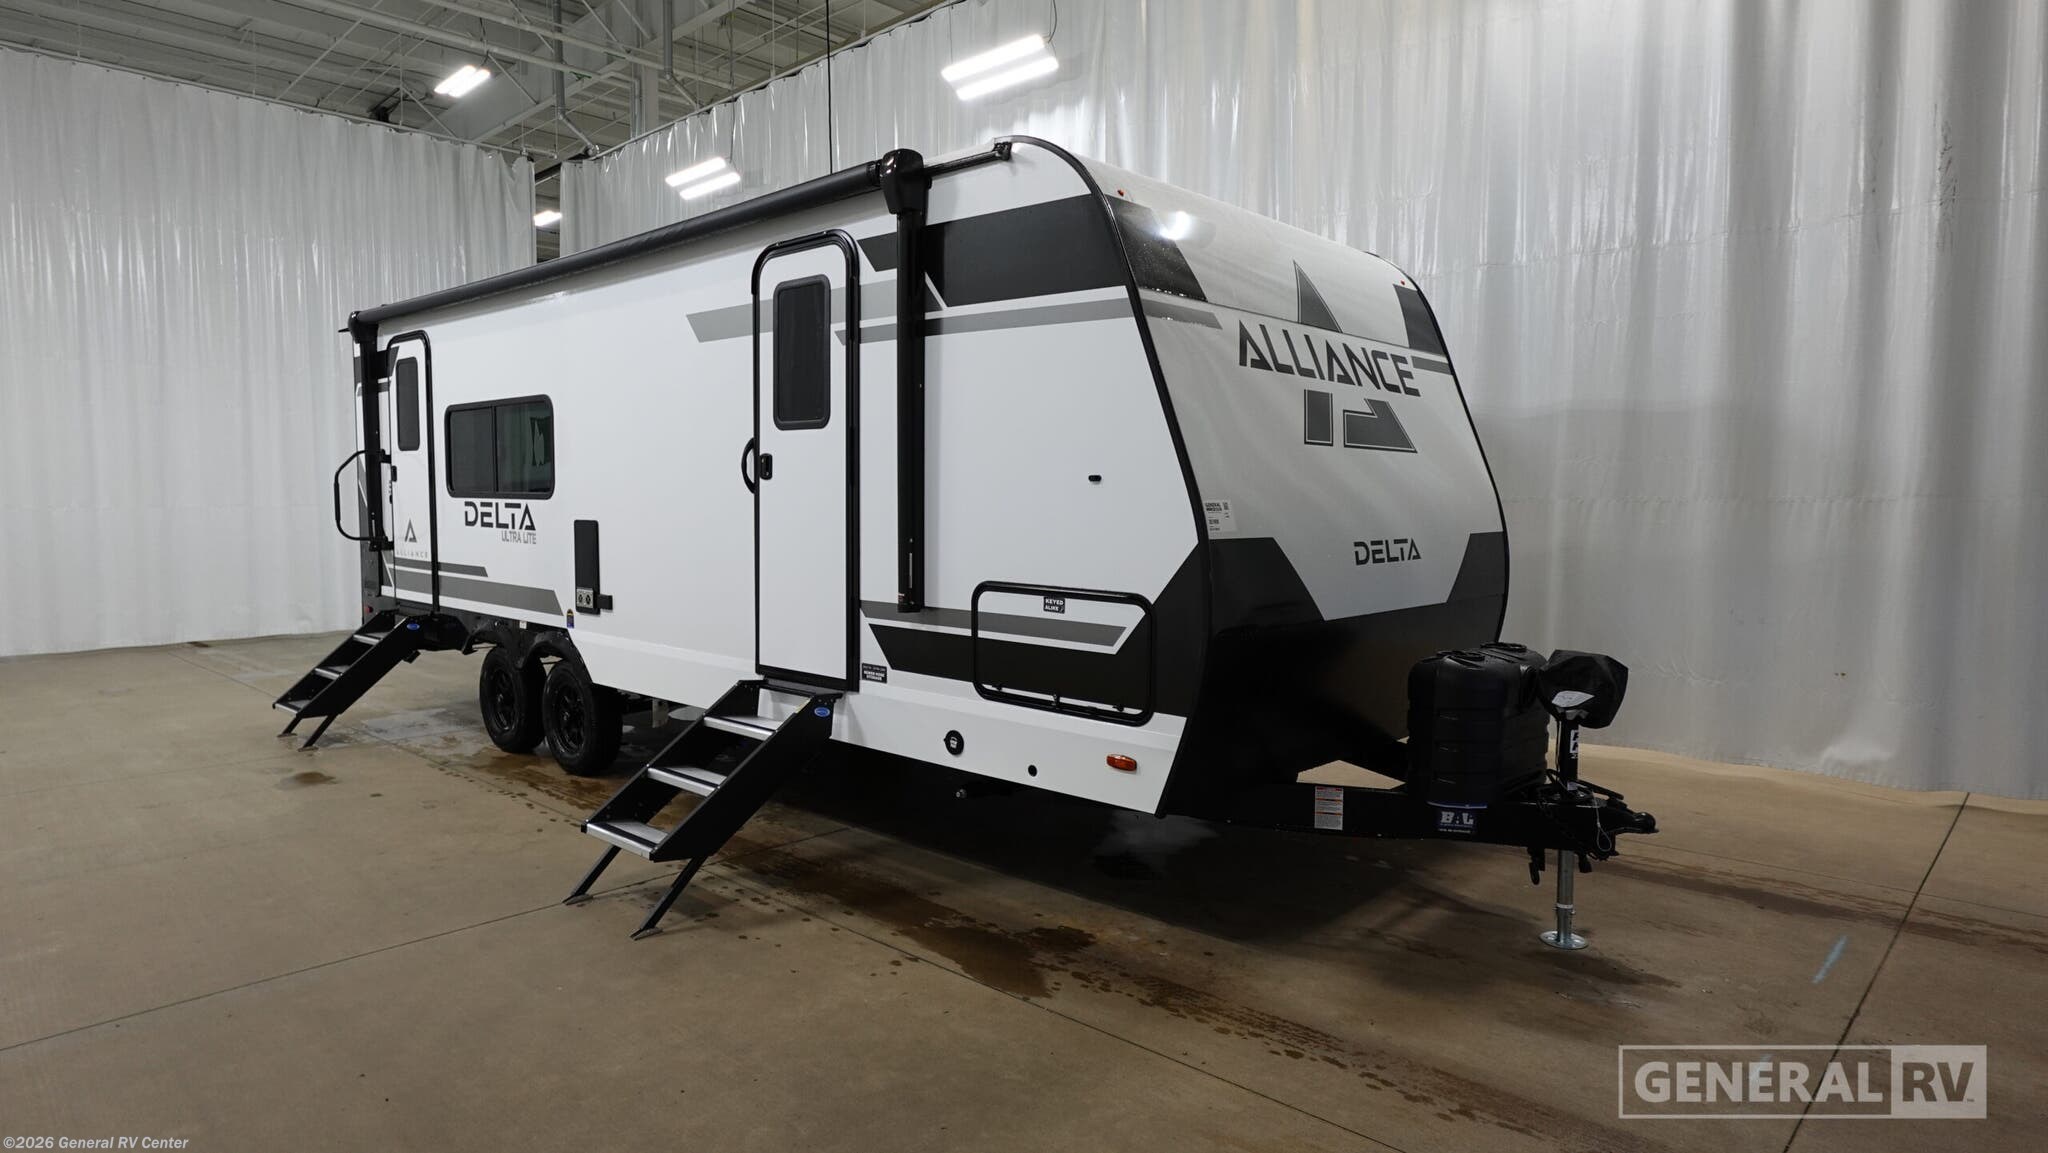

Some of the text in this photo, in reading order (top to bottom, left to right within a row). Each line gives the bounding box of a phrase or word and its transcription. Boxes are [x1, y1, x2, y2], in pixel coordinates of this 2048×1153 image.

[1238, 319, 1421, 397] ALLIANCE
[464, 501, 536, 530] DELTA
[501, 530, 537, 544] ULTRA LITE
[1353, 537, 1421, 565] DELTA
[1440, 811, 1474, 825] BL
